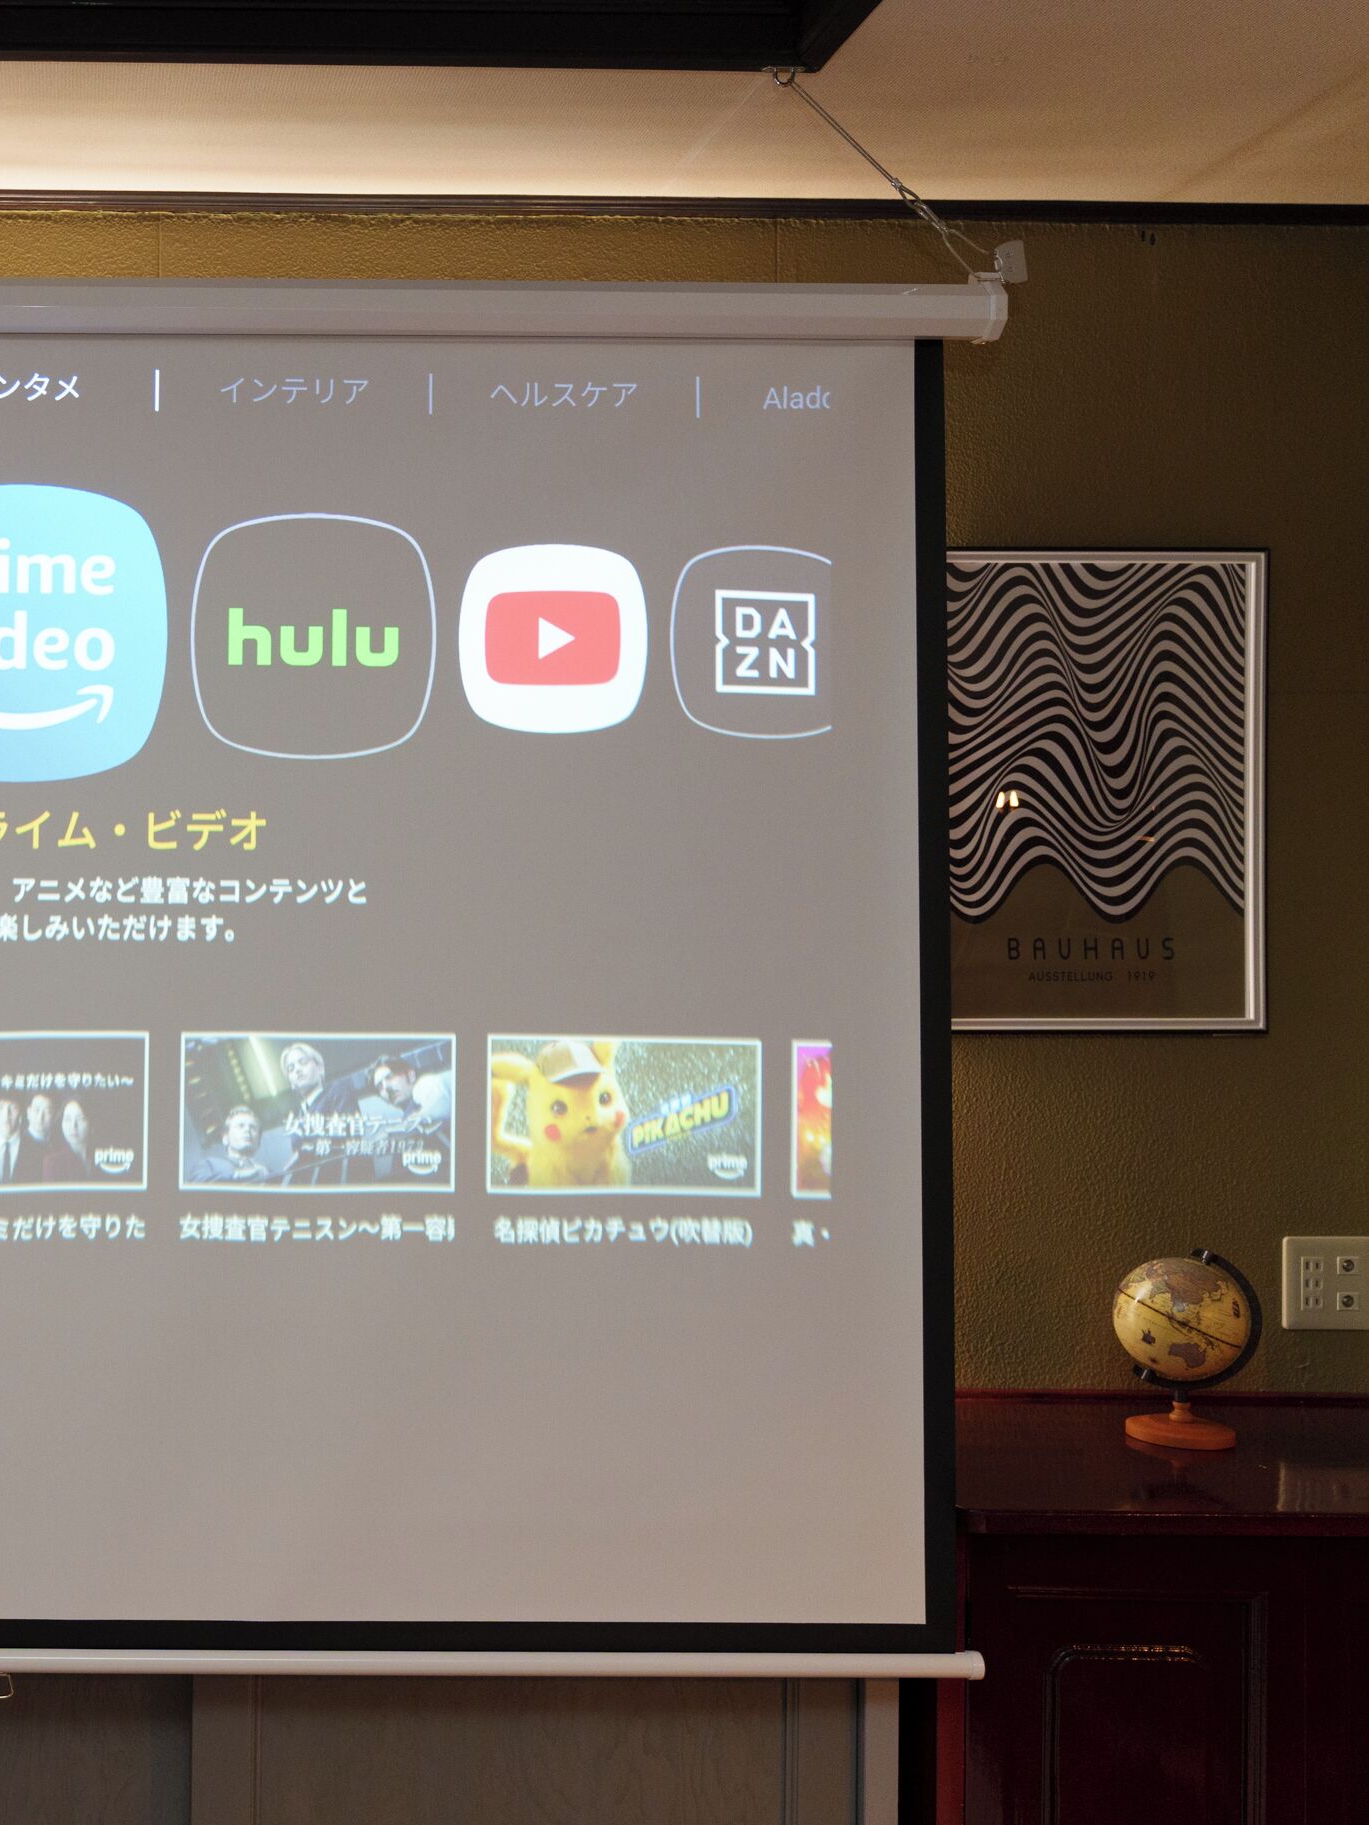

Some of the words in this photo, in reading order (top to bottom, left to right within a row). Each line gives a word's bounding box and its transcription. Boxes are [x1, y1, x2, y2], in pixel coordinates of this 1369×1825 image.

[219, 376, 370, 405] インテリア
[489, 381, 639, 408] ヘルスケア
[227, 607, 400, 668] hulu
[1007, 937, 1176, 961] BAUHAUS
